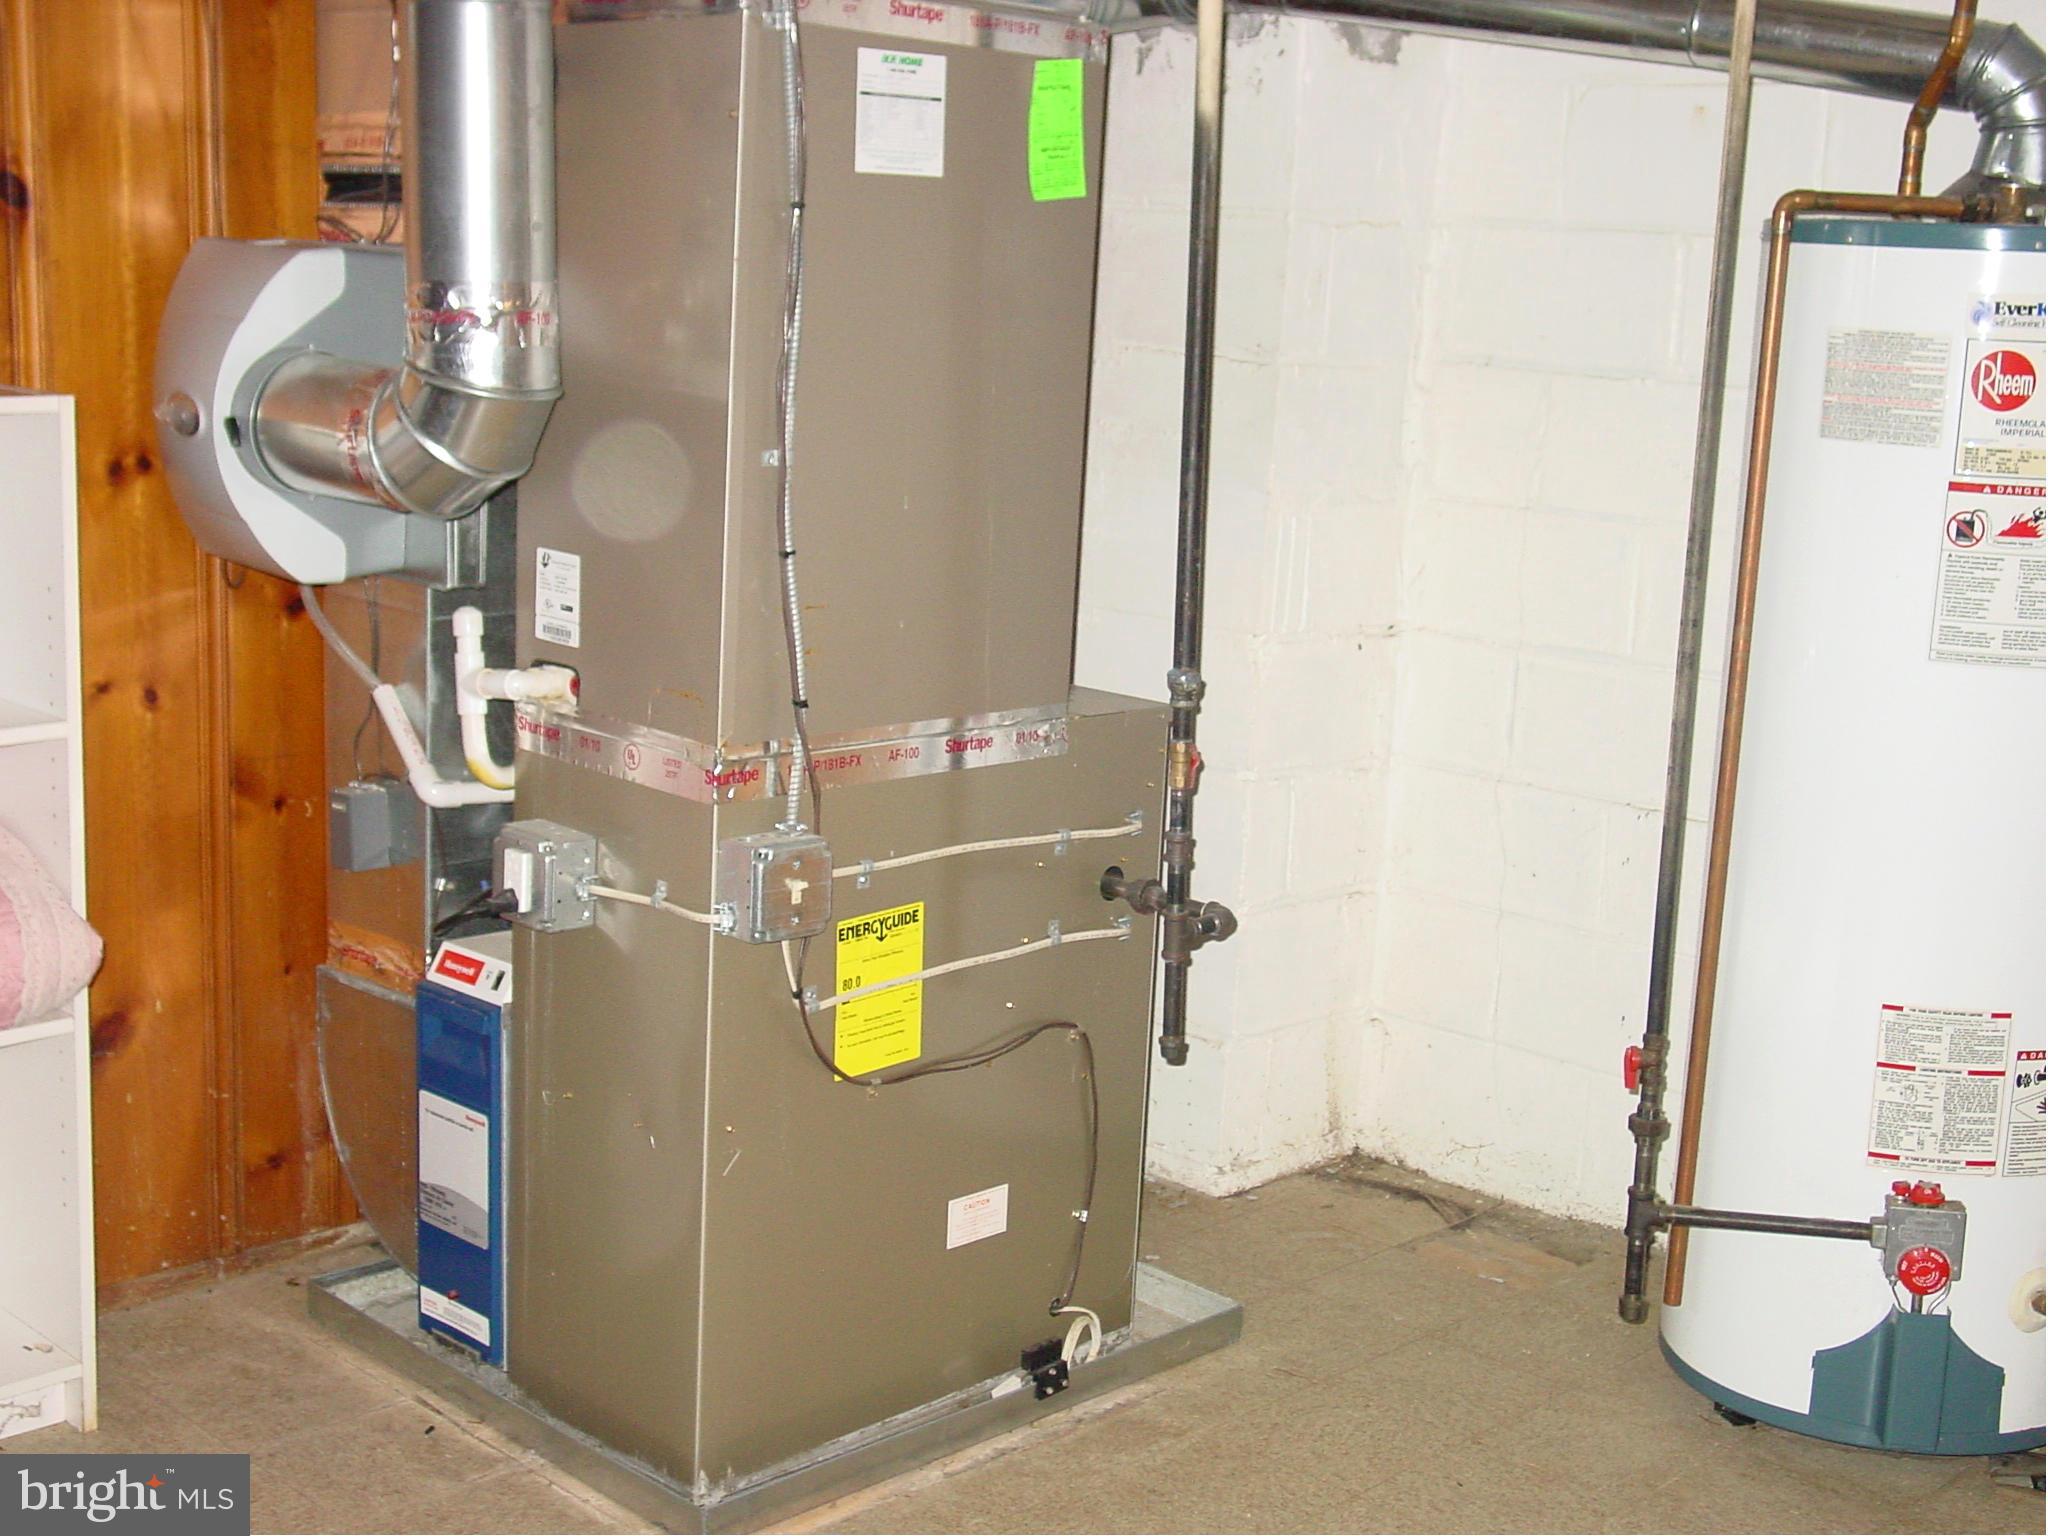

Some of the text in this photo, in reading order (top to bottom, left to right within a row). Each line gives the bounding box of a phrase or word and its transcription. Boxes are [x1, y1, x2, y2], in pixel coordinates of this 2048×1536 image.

[889, 0, 944, 23] Shurtape
[1977, 351, 2034, 404] Rheem
[518, 716, 561, 742] Shurtape
[888, 747, 919, 762] AF-100
[945, 736, 993, 754] Shurtape
[838, 909, 919, 942] ENERGYGUIDE
